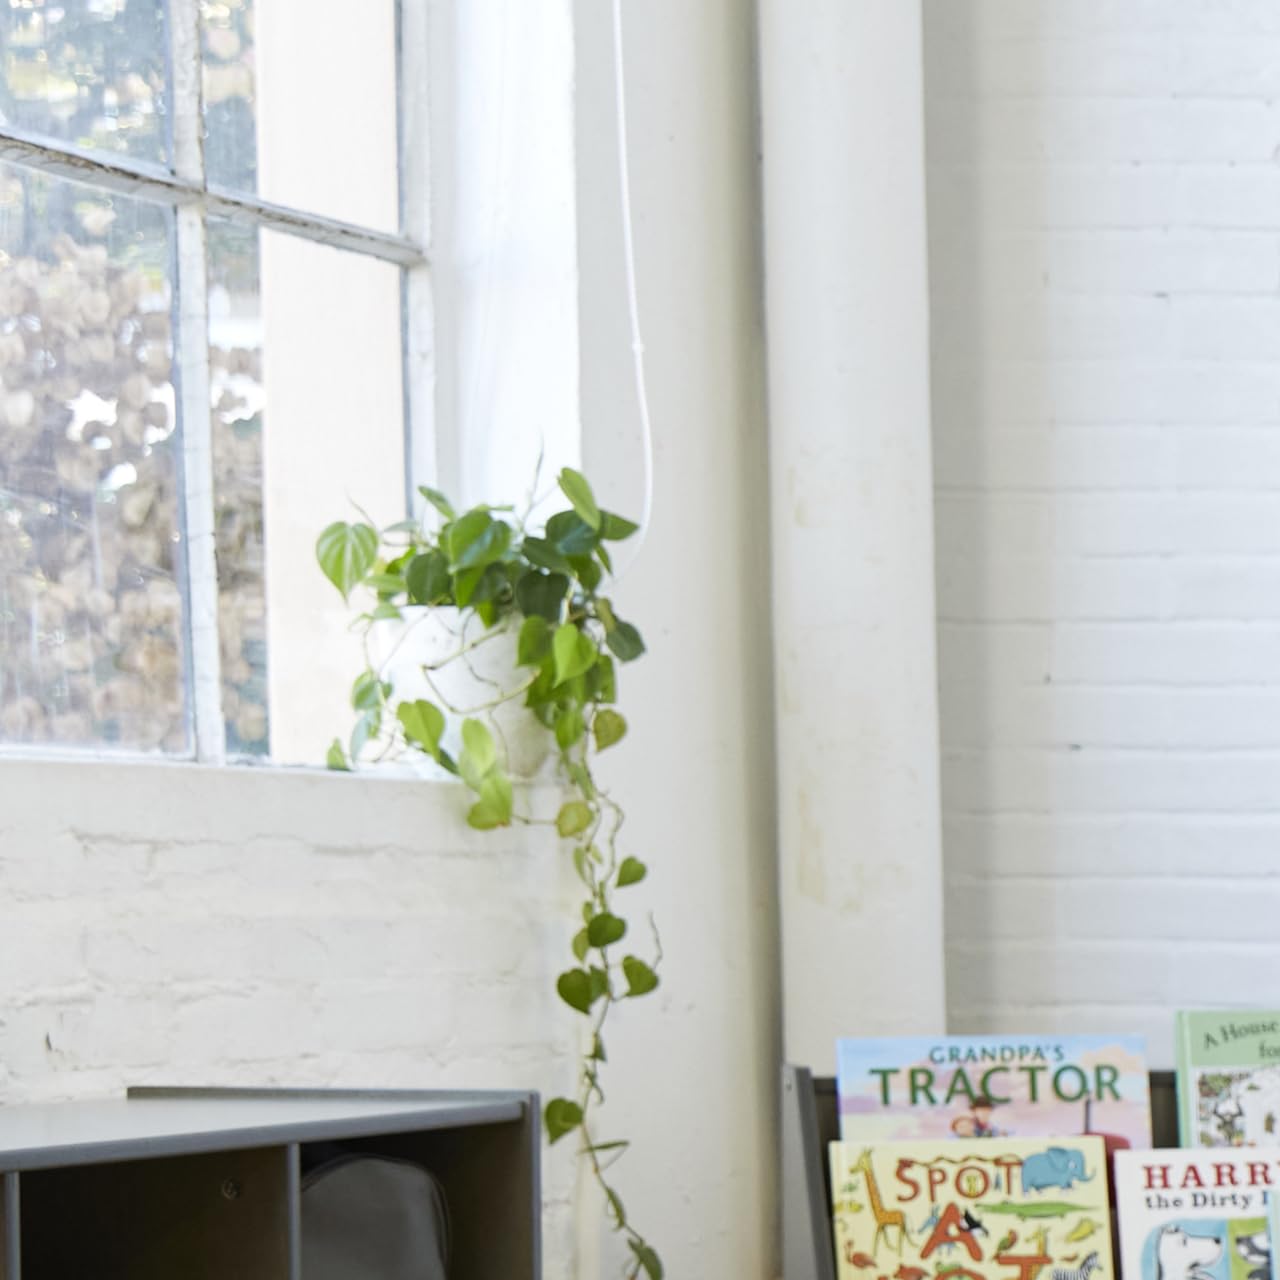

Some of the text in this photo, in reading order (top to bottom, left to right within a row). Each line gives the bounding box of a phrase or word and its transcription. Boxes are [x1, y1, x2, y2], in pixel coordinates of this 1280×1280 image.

[1203, 1032, 1219, 1050] A
[1220, 1021, 1279, 1043] House
[928, 1045, 1064, 1064] GRANDPA'S
[869, 1065, 1122, 1107] TRACTOR
[895, 1153, 1023, 1203] SPOT
[1146, 1192, 1184, 1209] the
[1192, 1191, 1251, 1211] Dirty
[920, 1202, 983, 1262] A
